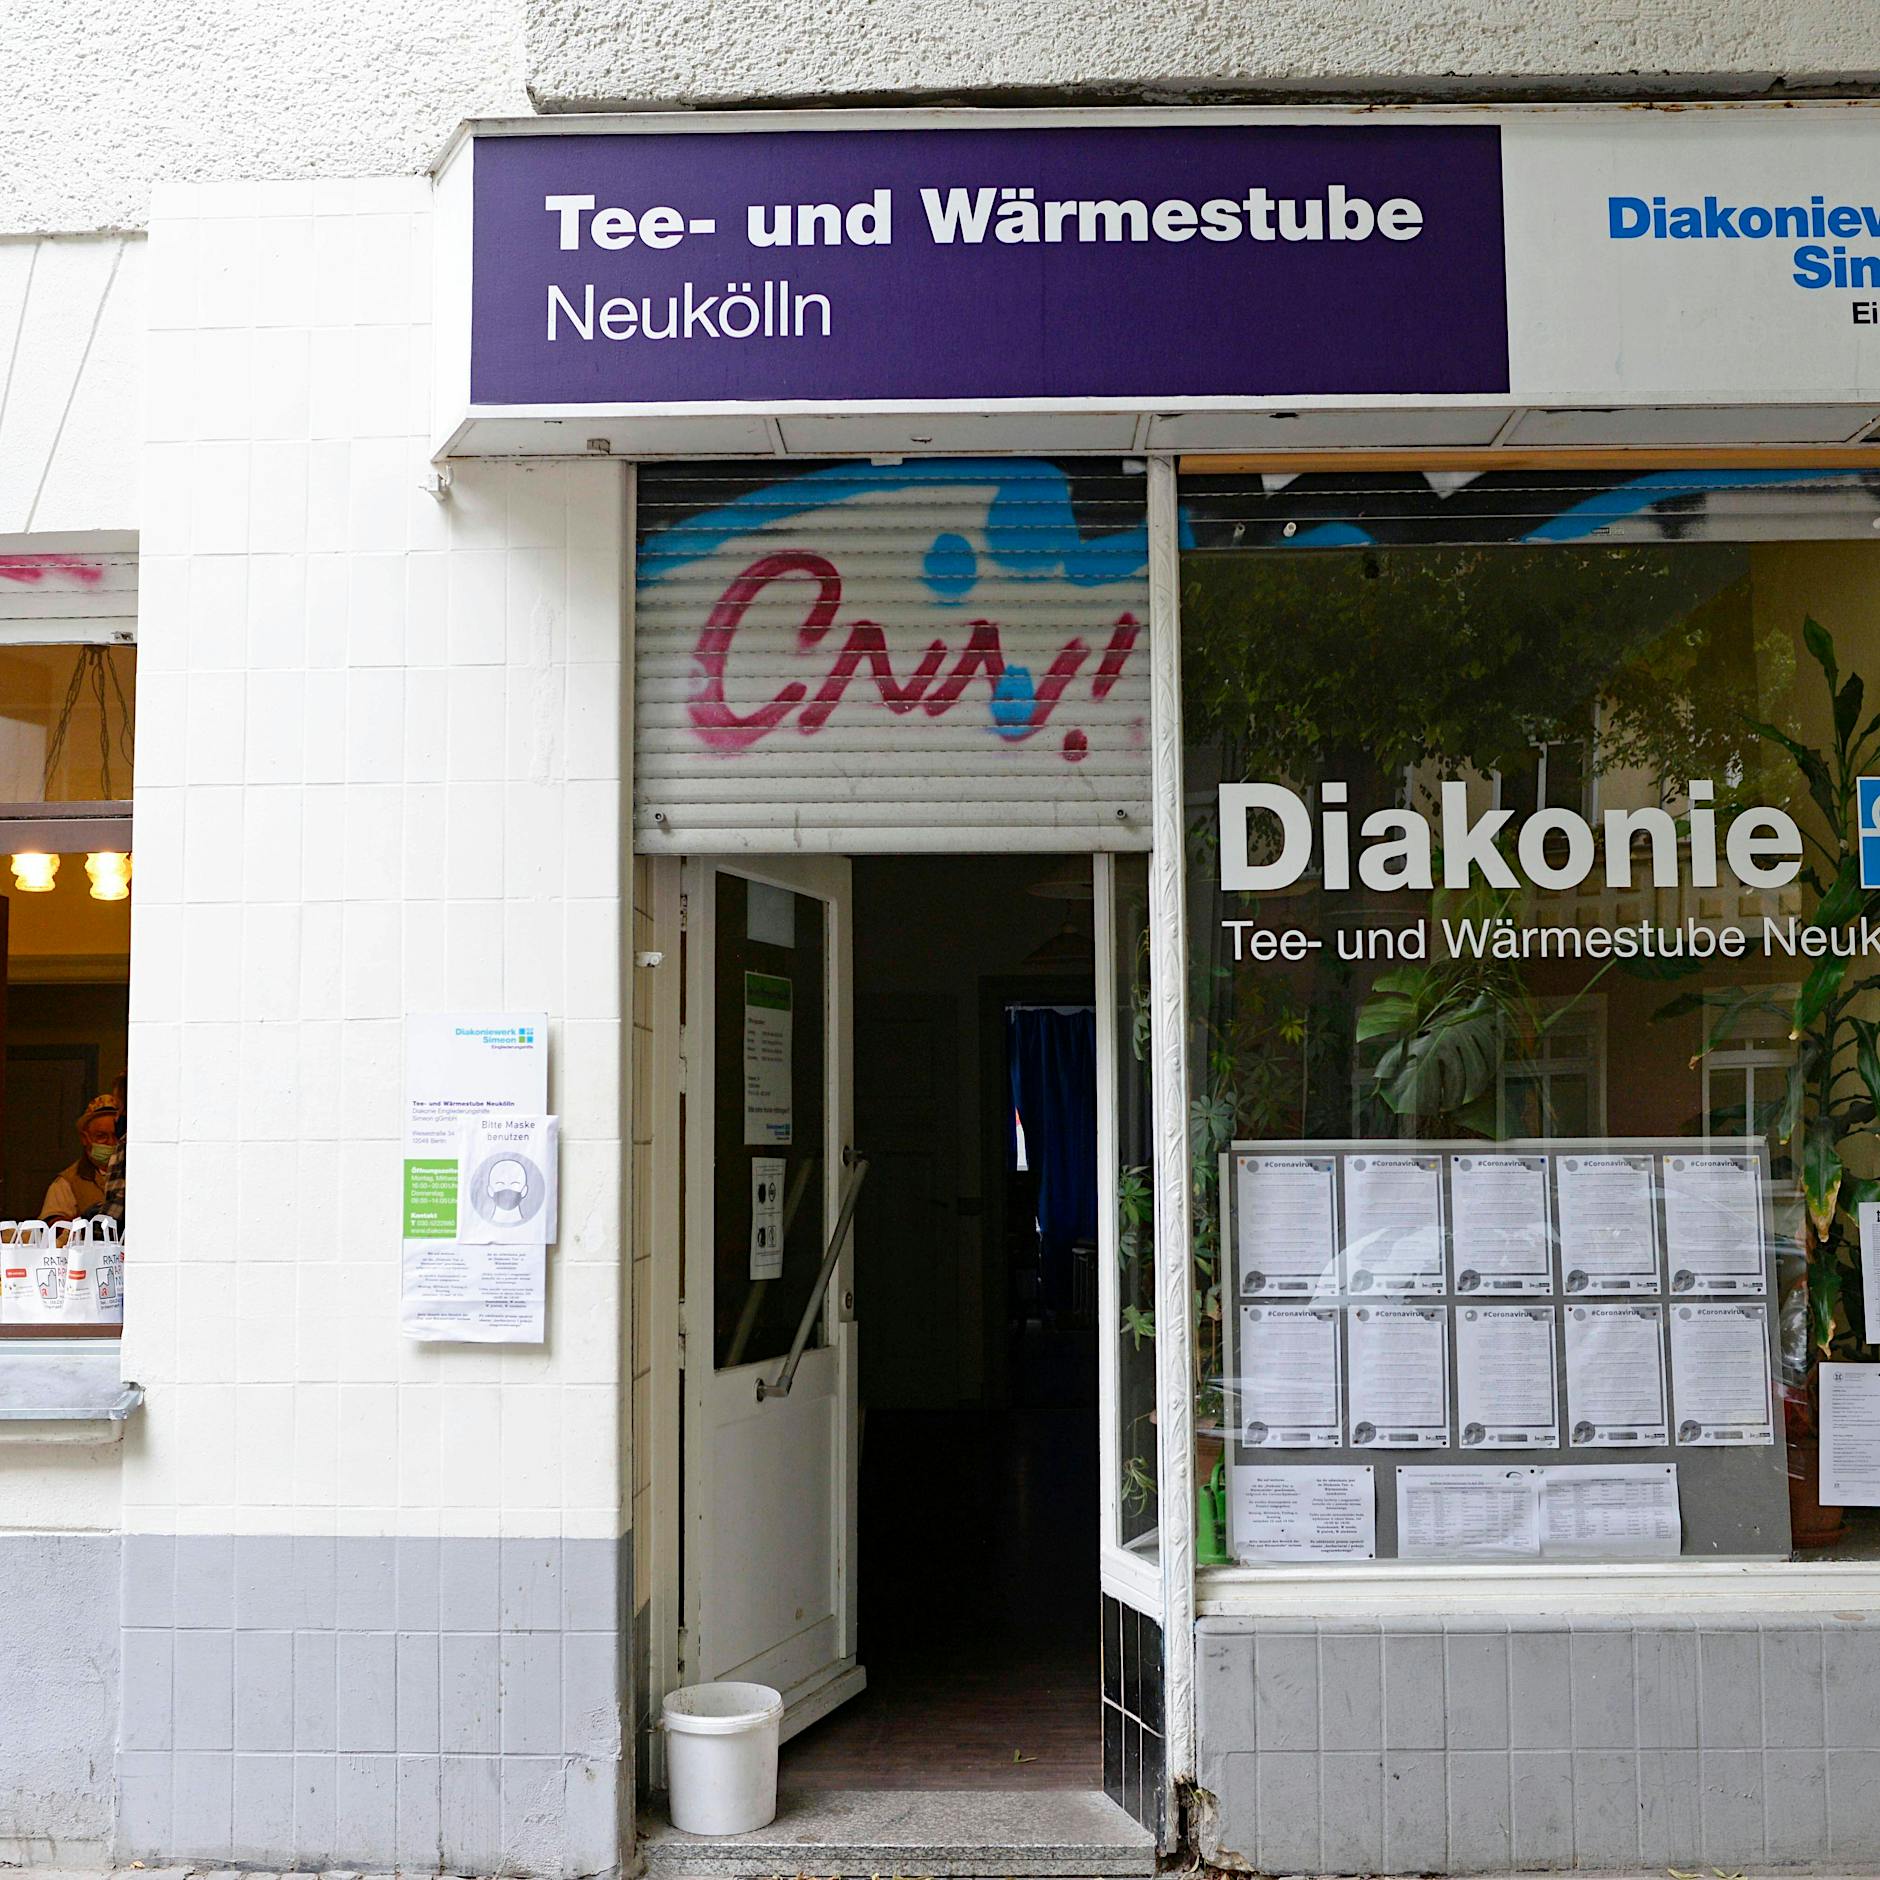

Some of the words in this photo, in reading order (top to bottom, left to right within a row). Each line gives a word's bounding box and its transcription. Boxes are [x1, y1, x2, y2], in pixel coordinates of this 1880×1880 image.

[546, 194, 716, 251] Tee-
[748, 189, 892, 248] und
[920, 184, 1423, 244] Wärmestube
[547, 280, 831, 341] Neukölln
[1218, 780, 1804, 895] Diakonie
[1222, 920, 1322, 961] Tee-
[1337, 919, 1426, 960] und
[1441, 917, 1746, 959] Wärmestube
[483, 1036, 516, 1044] Simeon
[481, 1121, 503, 1129] Bitte
[505, 1121, 536, 1129] Maske
[487, 1133, 530, 1142] benutzen
[1265, 1161, 1313, 1169] #Coronavirus
[1372, 1160, 1420, 1168] #Coronavirus
[1478, 1160, 1526, 1168] #Coronavirus
[1584, 1160, 1632, 1168] #Coronavirus
[1691, 1160, 1739, 1168] #Coronavirus
[1268, 1310, 1317, 1318] #Coronavirus
[1376, 1310, 1424, 1318] #Coronavirus
[1483, 1311, 1533, 1319] #Coronavirus
[1591, 1309, 1640, 1317] #Coronavirus
[1697, 1308, 1745, 1316] #Coronavirus
